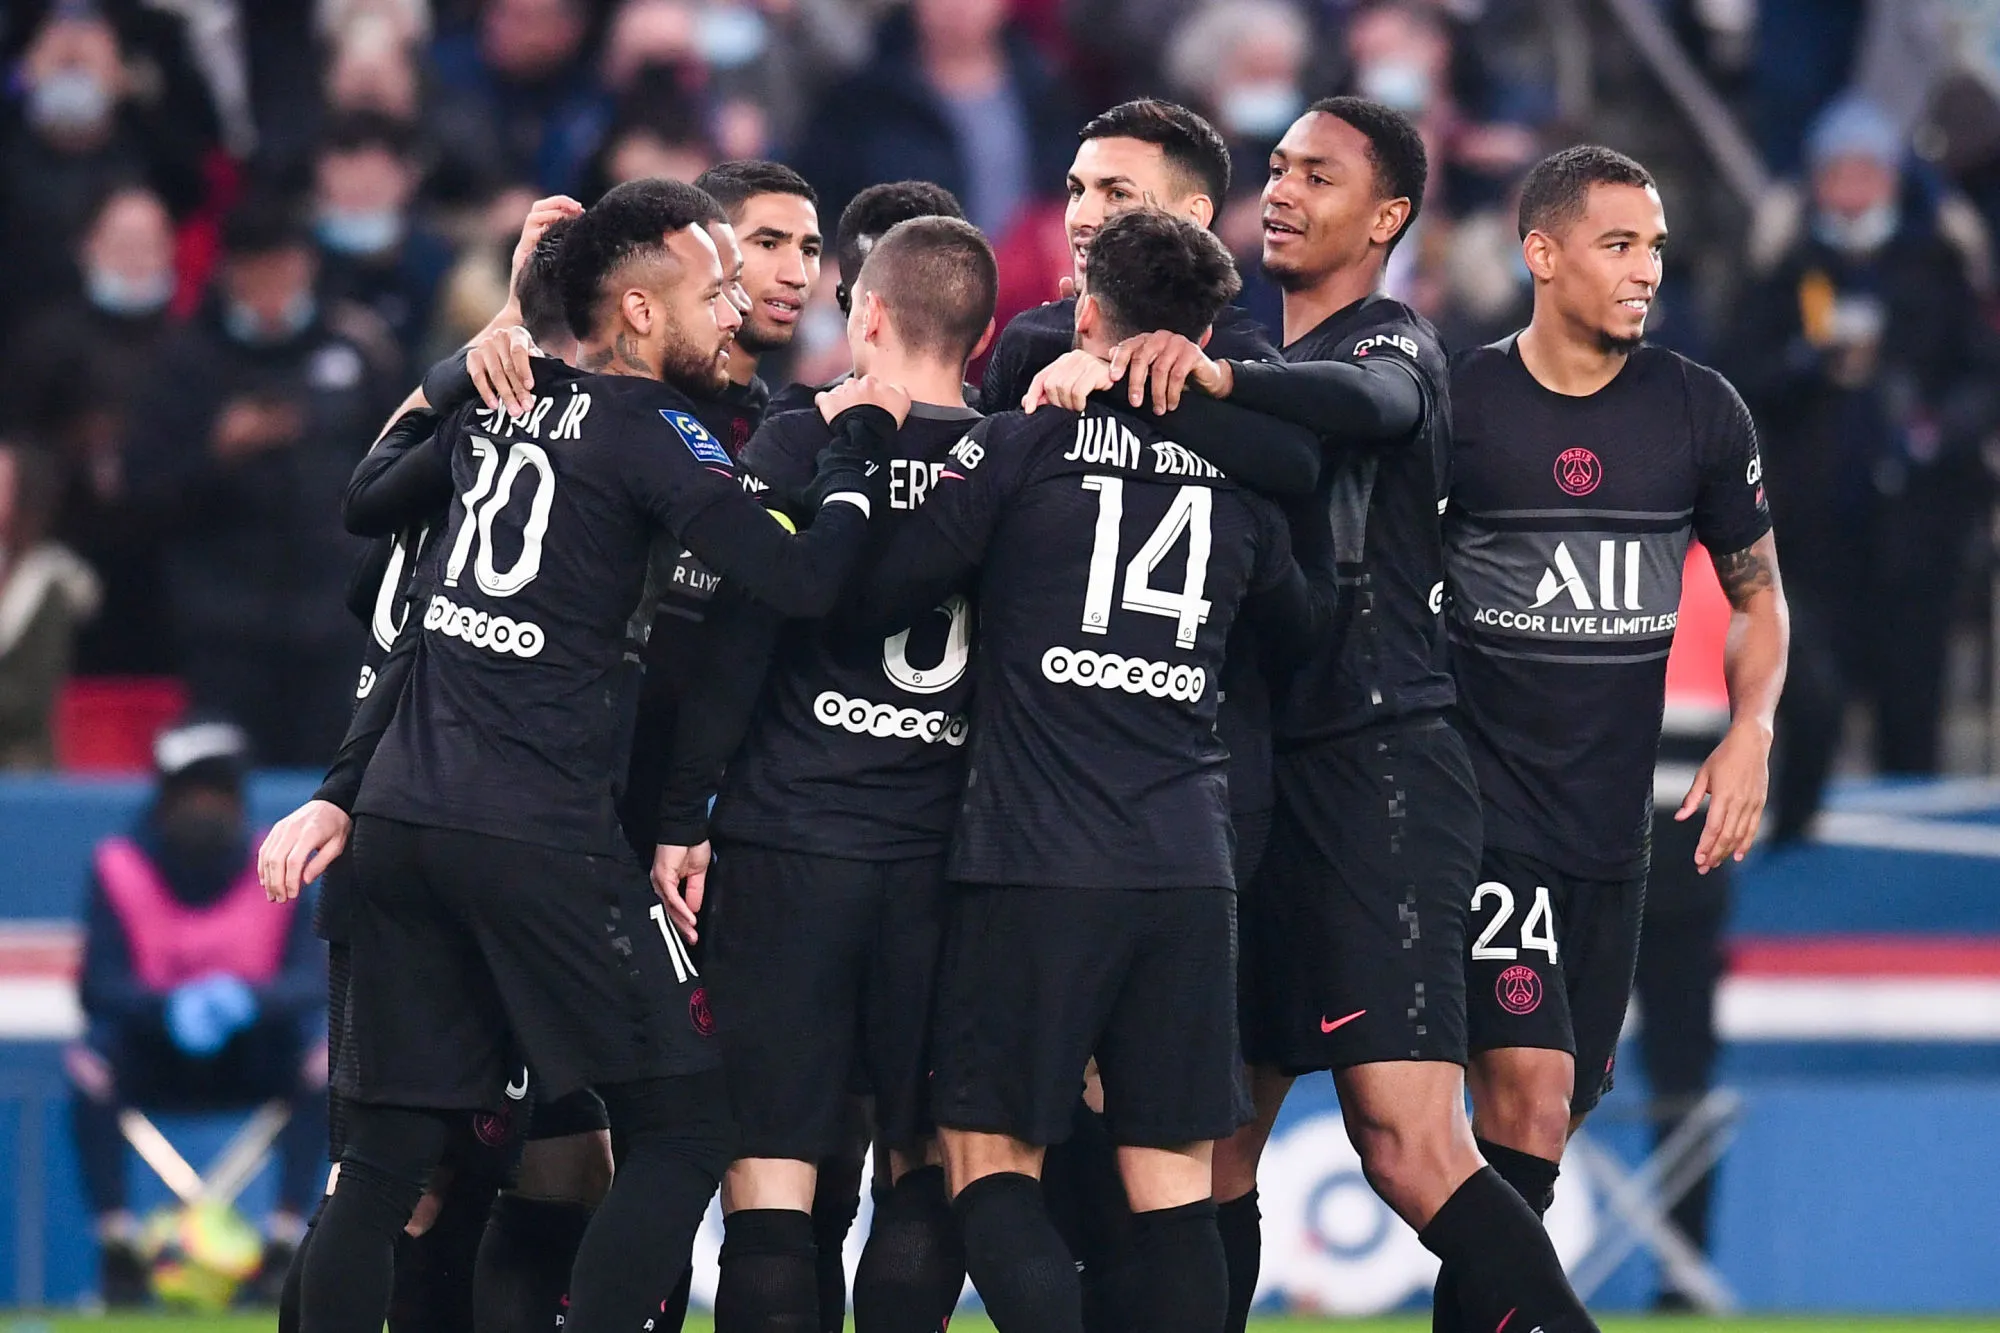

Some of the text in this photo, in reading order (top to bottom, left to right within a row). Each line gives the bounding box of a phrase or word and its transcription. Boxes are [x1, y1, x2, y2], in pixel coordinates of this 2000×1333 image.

[1353, 334, 1419, 358] QNB
[1063, 411, 1141, 470] JUAN
[1561, 450, 1593, 463] PARIS
[443, 435, 556, 597] 10
[1081, 475, 1212, 650] 14
[1474, 607, 1677, 635] ACCOR LIVE LIMITLESS
[1045, 651, 1202, 700] ooredoo
[1470, 881, 1558, 965] 24
[1503, 969, 1534, 981] PARIS
